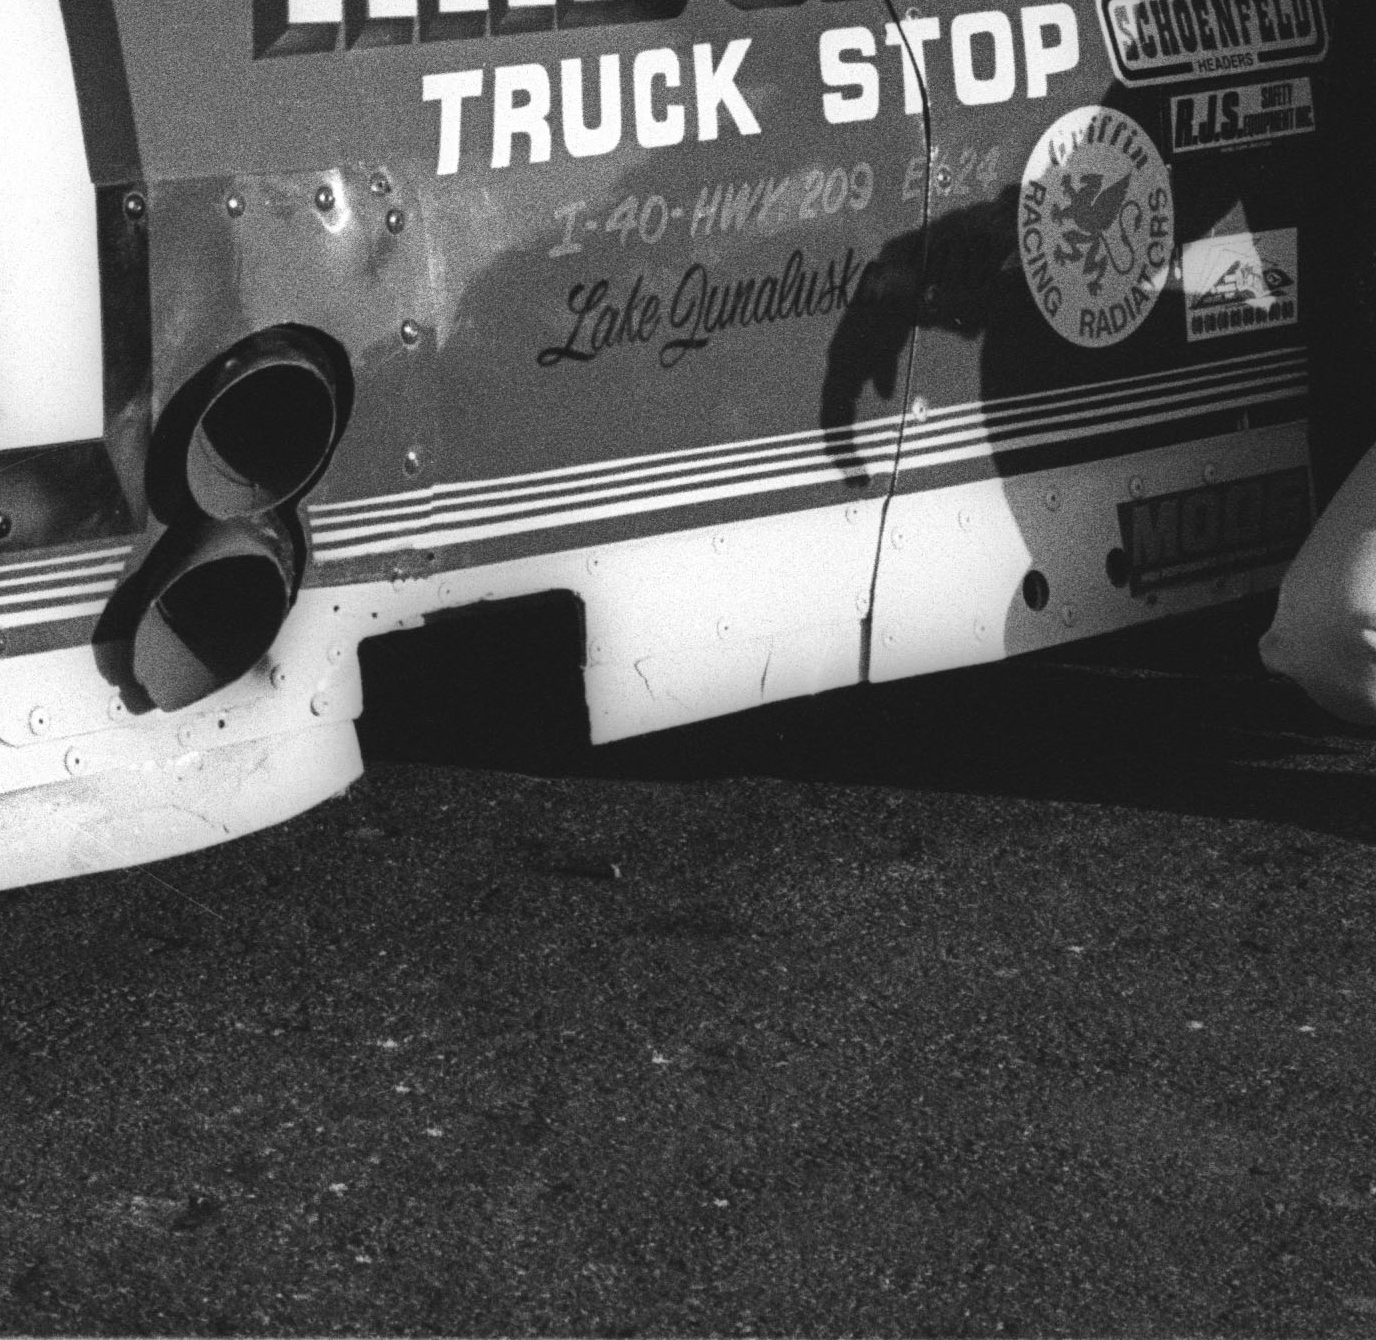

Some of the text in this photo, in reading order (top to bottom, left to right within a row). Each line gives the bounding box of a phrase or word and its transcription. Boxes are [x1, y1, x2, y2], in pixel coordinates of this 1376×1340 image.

[421, 1, 1081, 176] TRUCK STOP
[1196, 52, 1255, 73] HEADERS
[1175, 91, 1244, 148] R.J.S.
[1261, 83, 1293, 109] SAFETY
[798, 161, 875, 220] 209
[1022, 179, 1169, 339] RACING RADIATORS
[537, 271, 662, 367] Lake
